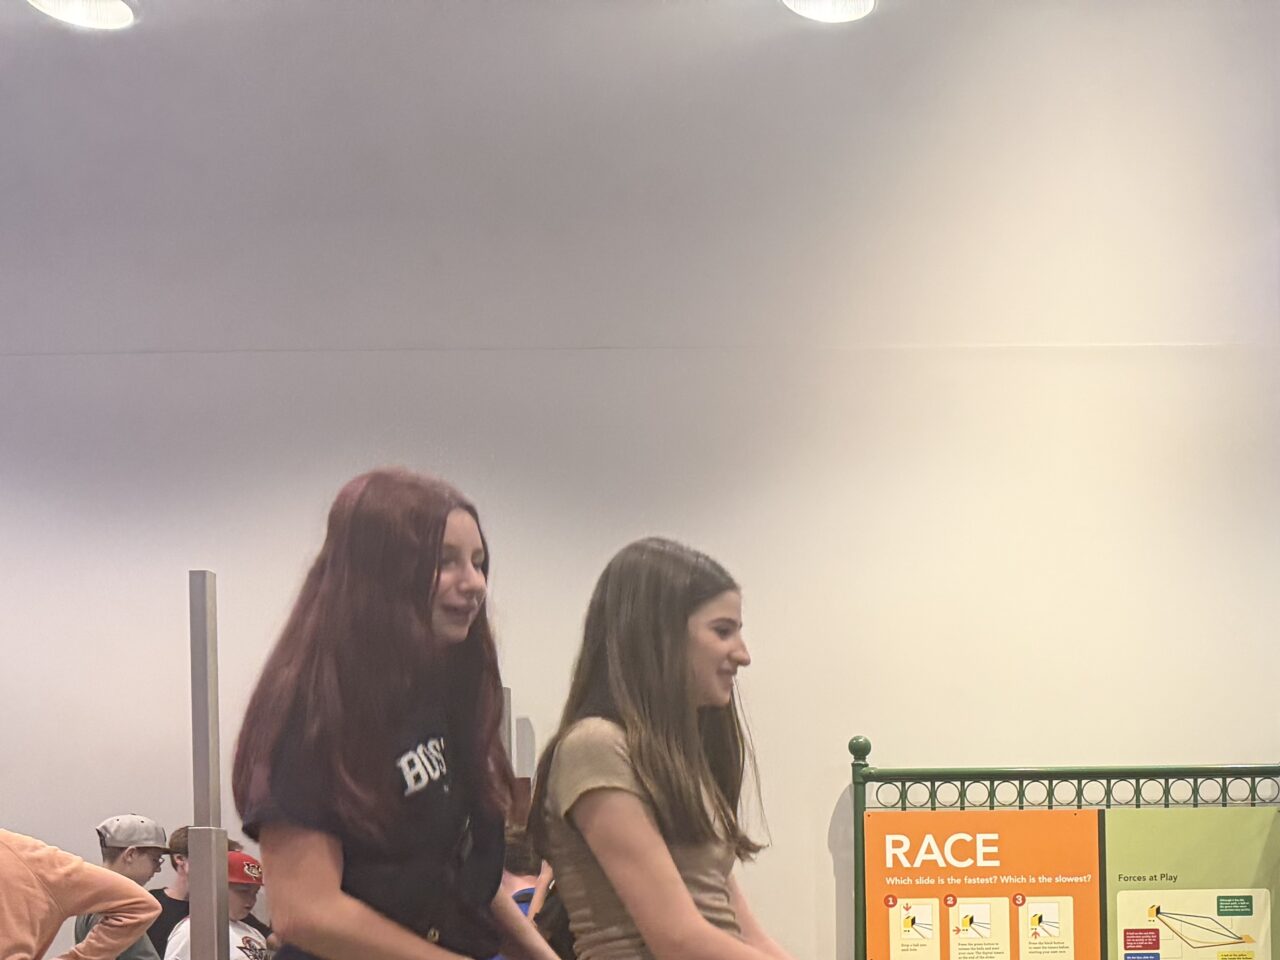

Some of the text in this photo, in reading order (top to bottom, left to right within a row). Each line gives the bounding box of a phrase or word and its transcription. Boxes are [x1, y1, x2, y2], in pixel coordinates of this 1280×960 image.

[396, 736, 446, 796] BOS
[885, 832, 1001, 868] RACE
[885, 874, 1092, 885] Which slide is the fastest? Which is the slowest?
[1118, 874, 1147, 882] Forces
[1160, 873, 1178, 883] Play
[887, 897, 894, 905] 1
[946, 896, 954, 905] 2
[1015, 895, 1023, 904] 3
